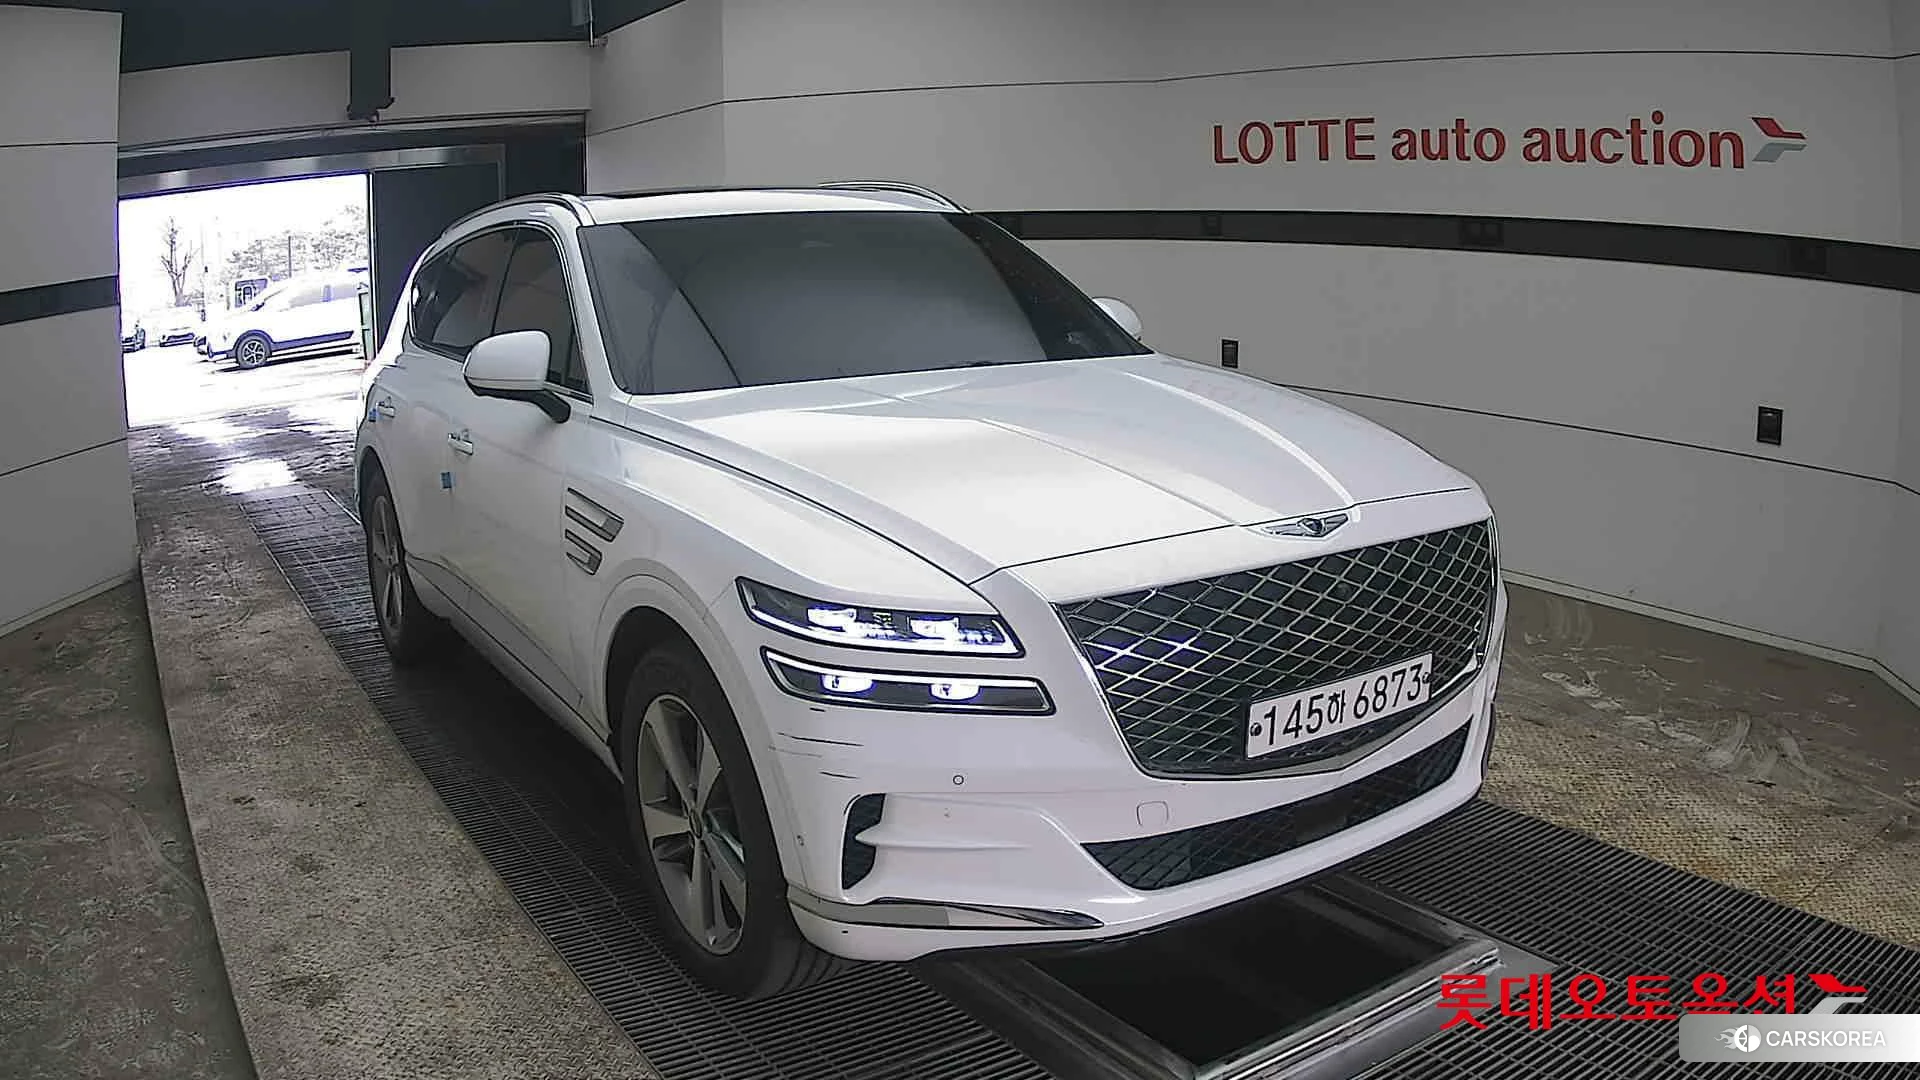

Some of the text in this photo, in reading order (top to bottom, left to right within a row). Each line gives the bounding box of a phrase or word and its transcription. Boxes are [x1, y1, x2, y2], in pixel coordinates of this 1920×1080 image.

[1212, 111, 1744, 168] LOTTE auto auction
[1263, 663, 1423, 746] 145하 6873
